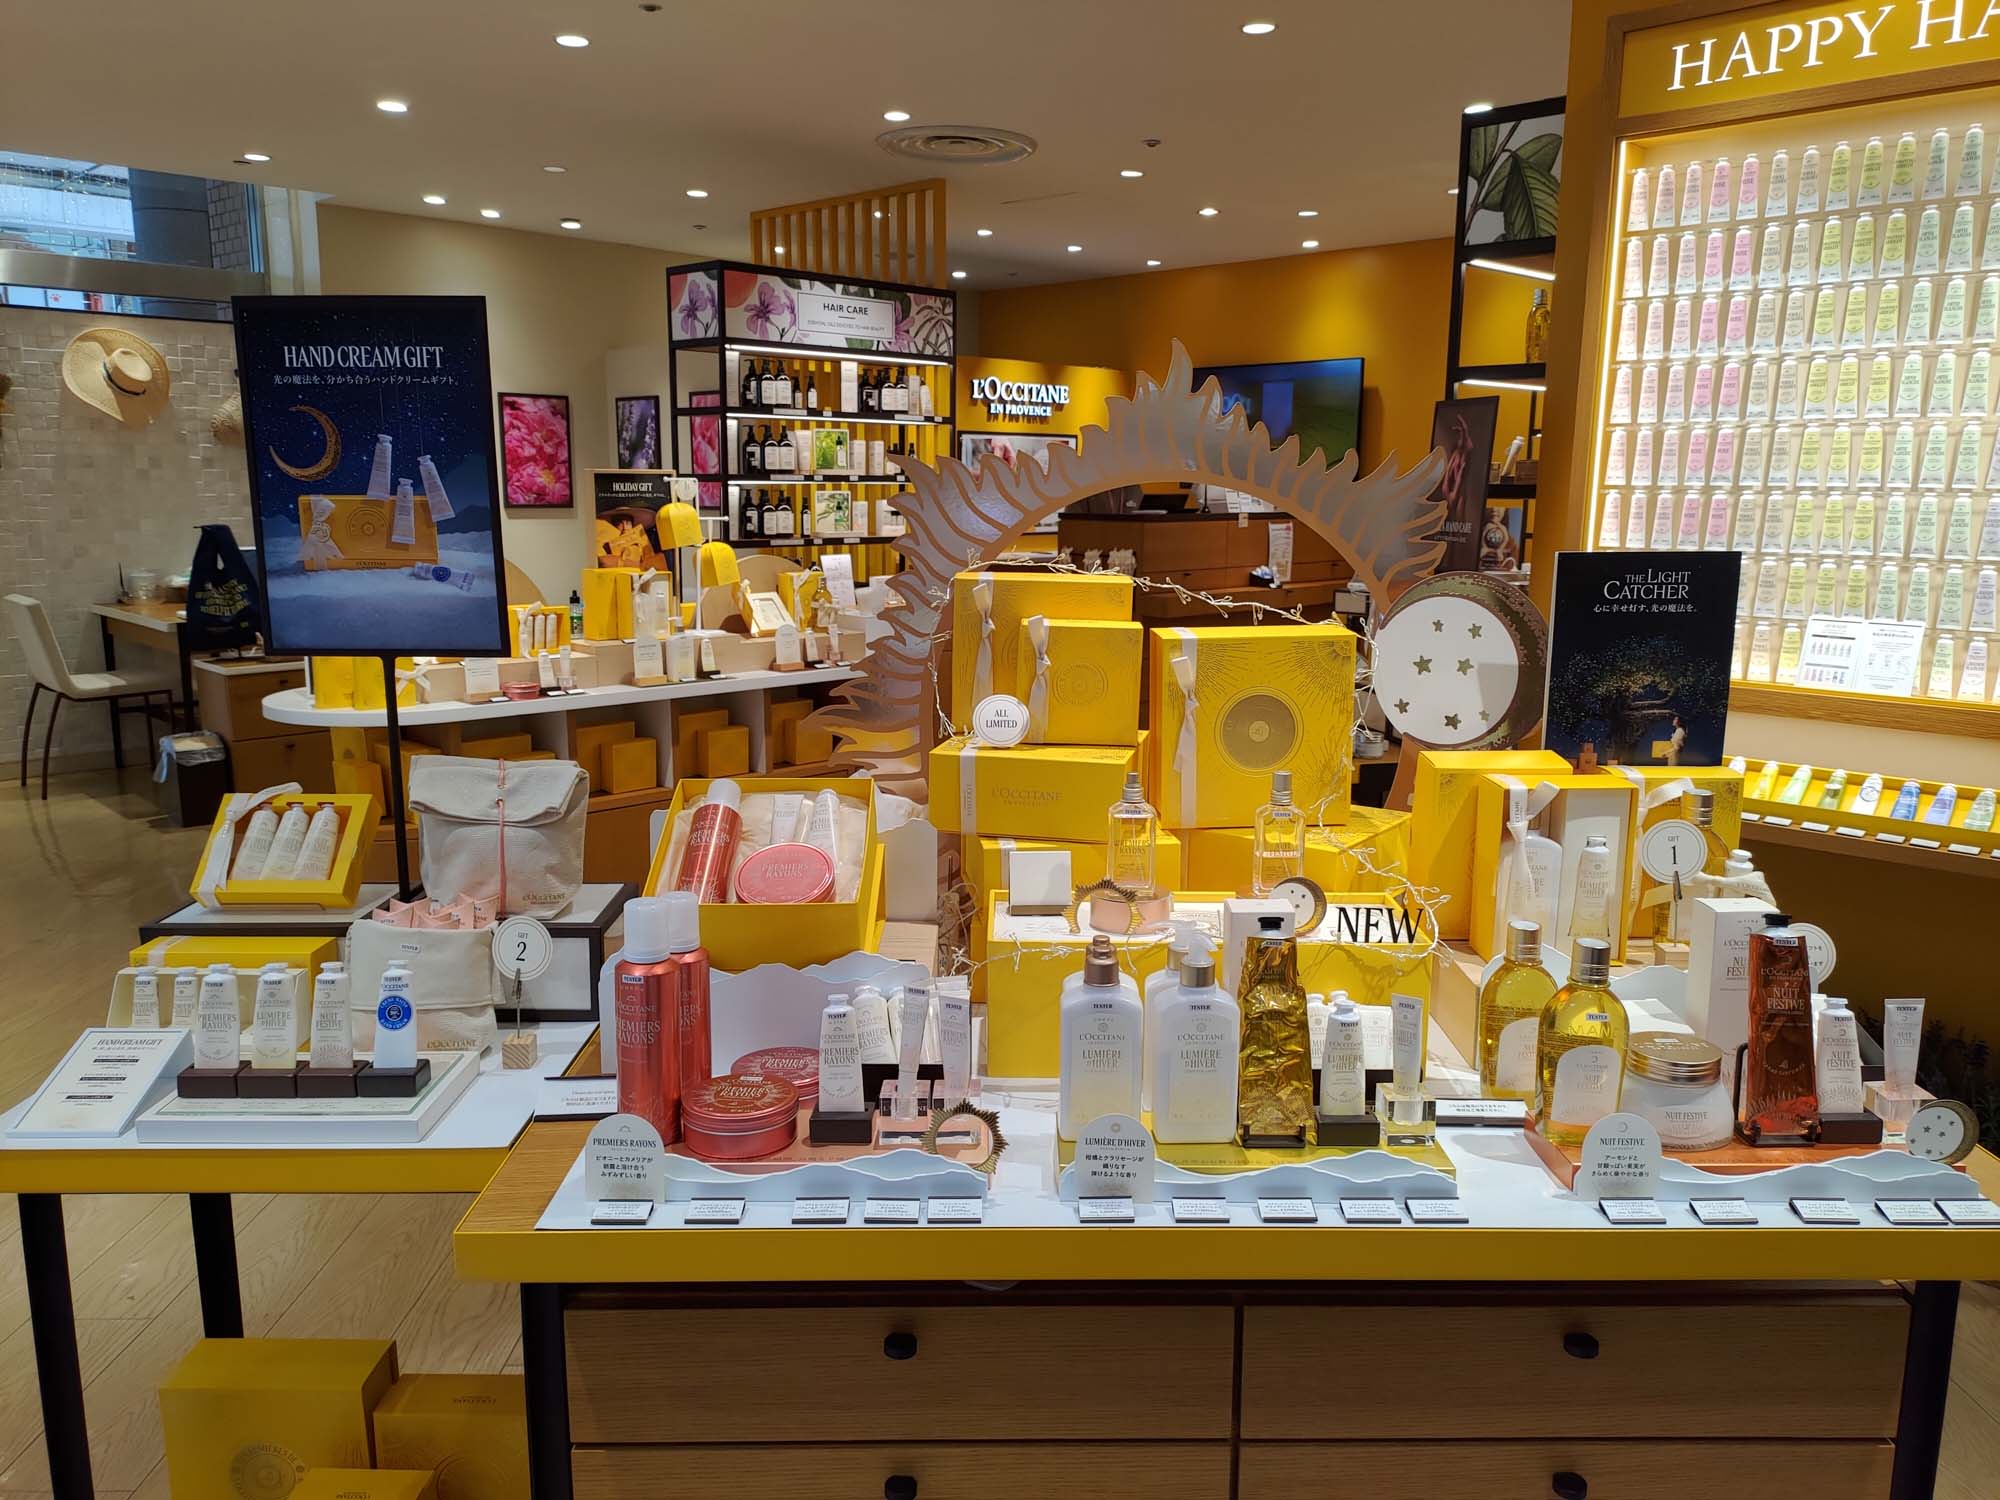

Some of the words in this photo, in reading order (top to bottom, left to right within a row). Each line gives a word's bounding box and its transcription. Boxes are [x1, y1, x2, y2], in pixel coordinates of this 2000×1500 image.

[1667, 5, 1896, 91] HAPPY
[823, 302, 844, 313] HAIR
[846, 305, 868, 315] CARE
[284, 345, 335, 368] HAND
[337, 345, 400, 368] CREAM
[403, 345, 445, 368] GIFT
[972, 375, 1070, 404] L'OCCITANE
[990, 402, 1003, 414] EN
[1005, 403, 1052, 417] PROVENCE
[612, 482, 638, 491] HOLIDAY
[1625, 574, 1645, 583] THE
[1647, 568, 1691, 583] LIGHT
[1603, 580, 1689, 600] CATCHER
[994, 709, 1008, 718] ALL
[985, 719, 1018, 729] LIMITED
[1672, 845, 1678, 866] 1
[1336, 906, 1424, 944] NEW
[518, 932, 529, 940] GIFT
[515, 941, 527, 962] 2
[1726, 966, 1750, 977] FEST
[1772, 987, 1800, 999] NUIT
[617, 1003, 656, 1013] OCCITANE
[1767, 998, 1806, 1010] FESTIVE
[1079, 1032, 1126, 1041] L'OCCITANE
[1177, 1032, 1225, 1041] L'OCCITANE
[824, 1056, 856, 1065] RAYONS
[1831, 1050, 1852, 1060] NUIT
[1826, 1059, 1857, 1068] FESTIVE
[1665, 1111, 1682, 1120] NUIT
[1683, 1111, 1709, 1120] FESTIVE
[592, 1138, 629, 1147] PREMIERS
[629, 1139, 656, 1148] RAYONS
[1085, 1136, 1116, 1147] LUMIÈRE
[1116, 1138, 1146, 1148] D'HIVER
[1600, 1137, 1616, 1145] NUIT
[1616, 1137, 1645, 1146] FESTIVE
